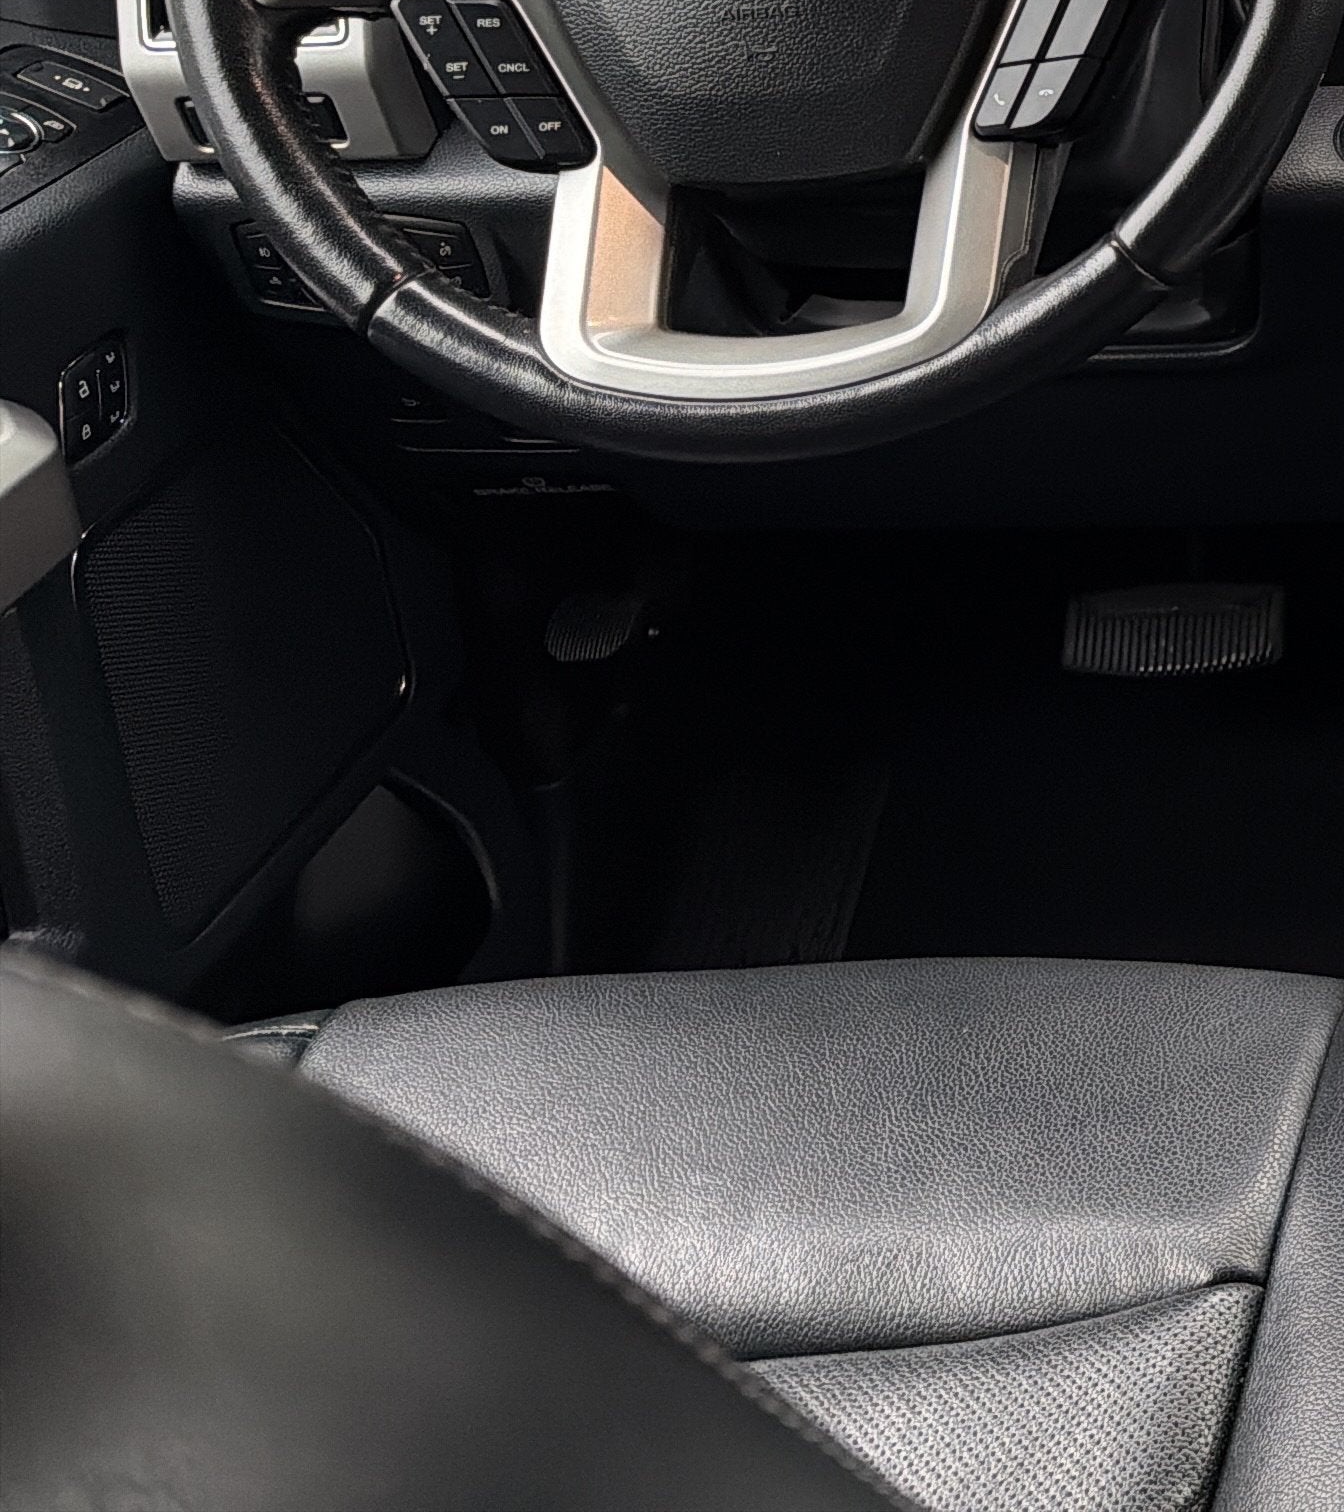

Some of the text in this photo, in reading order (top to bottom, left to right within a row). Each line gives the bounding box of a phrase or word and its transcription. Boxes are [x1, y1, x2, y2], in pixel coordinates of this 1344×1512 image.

[721, 4, 801, 22] AIRBAG
[419, 15, 442, 26] SET
[476, 18, 501, 28] RES
[445, 61, 468, 73] SET
[498, 62, 530, 73] CNCL
[489, 125, 508, 135] ON
[538, 121, 562, 133] OFF
